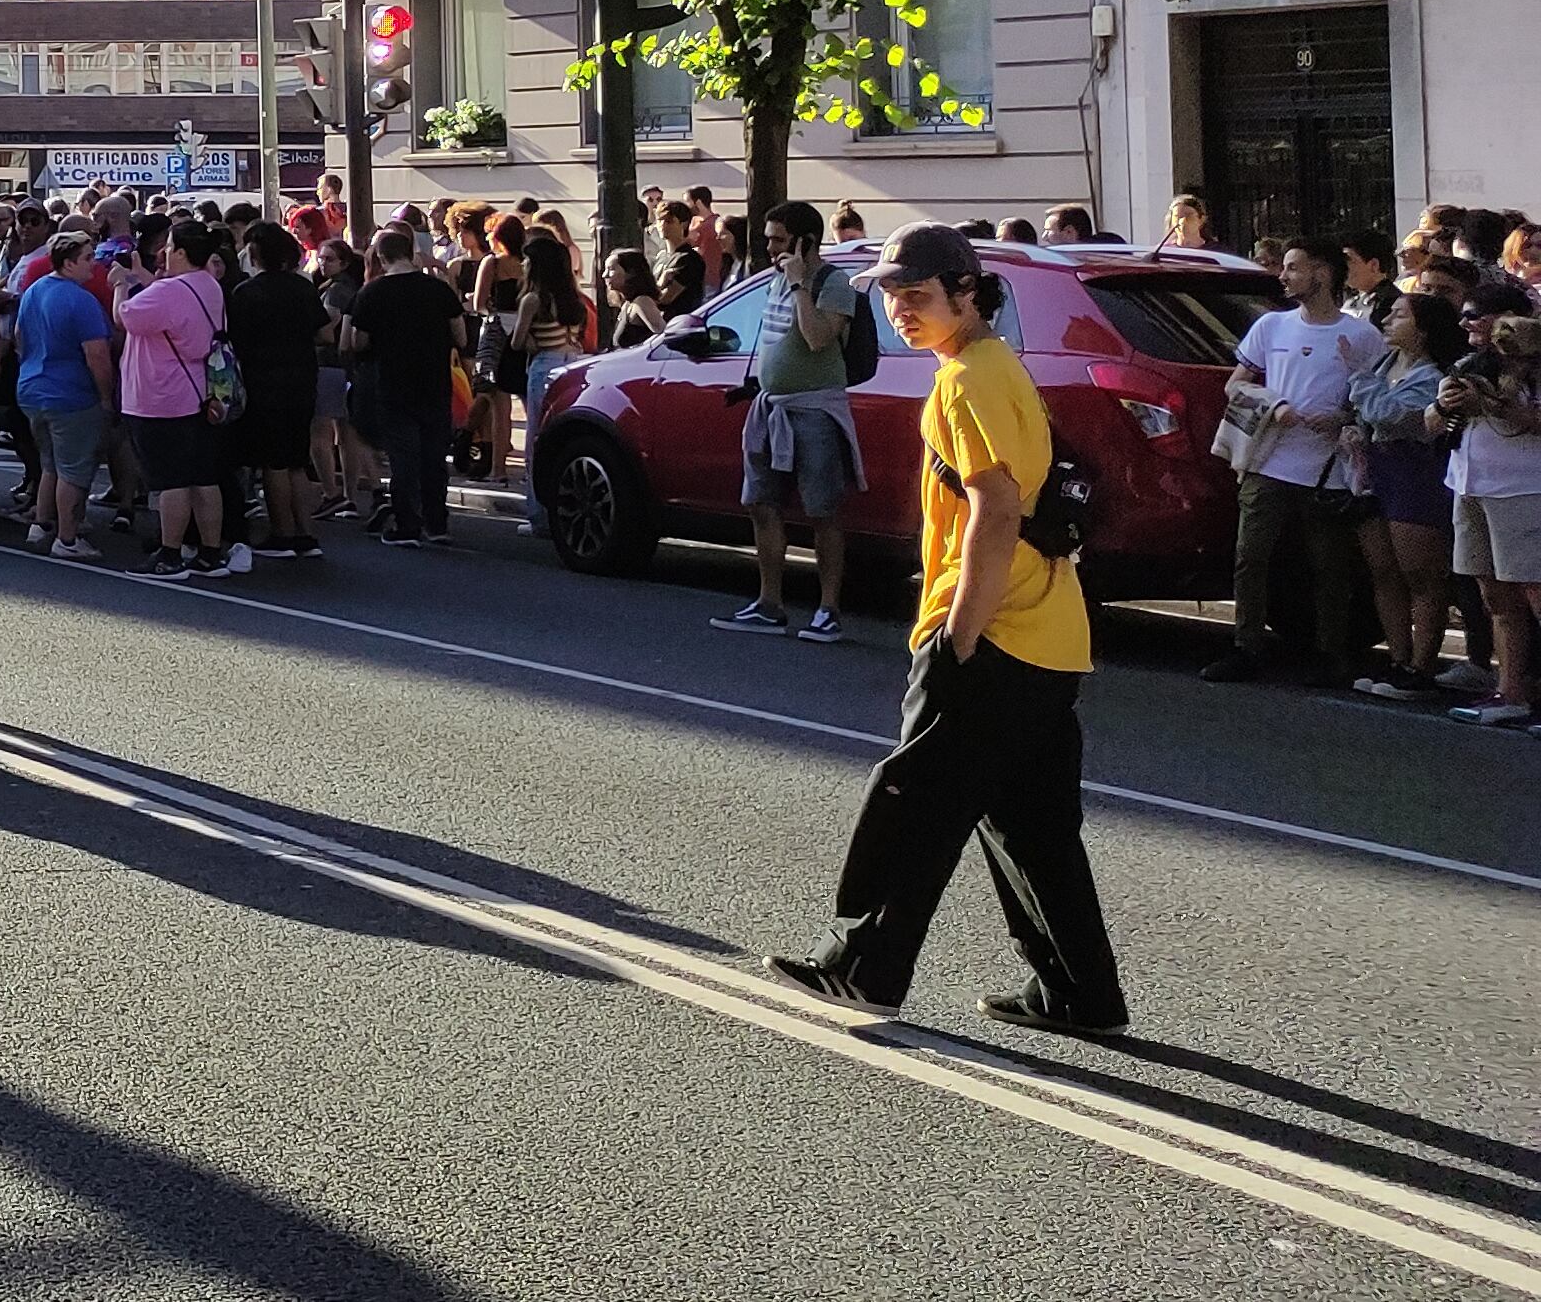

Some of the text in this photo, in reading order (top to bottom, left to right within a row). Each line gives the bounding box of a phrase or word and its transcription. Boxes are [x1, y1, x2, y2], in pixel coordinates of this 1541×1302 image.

[1297, 50, 1312, 67] 90
[54, 152, 159, 166] CERTIFICADOS
[197, 175, 230, 183] ARMAS
